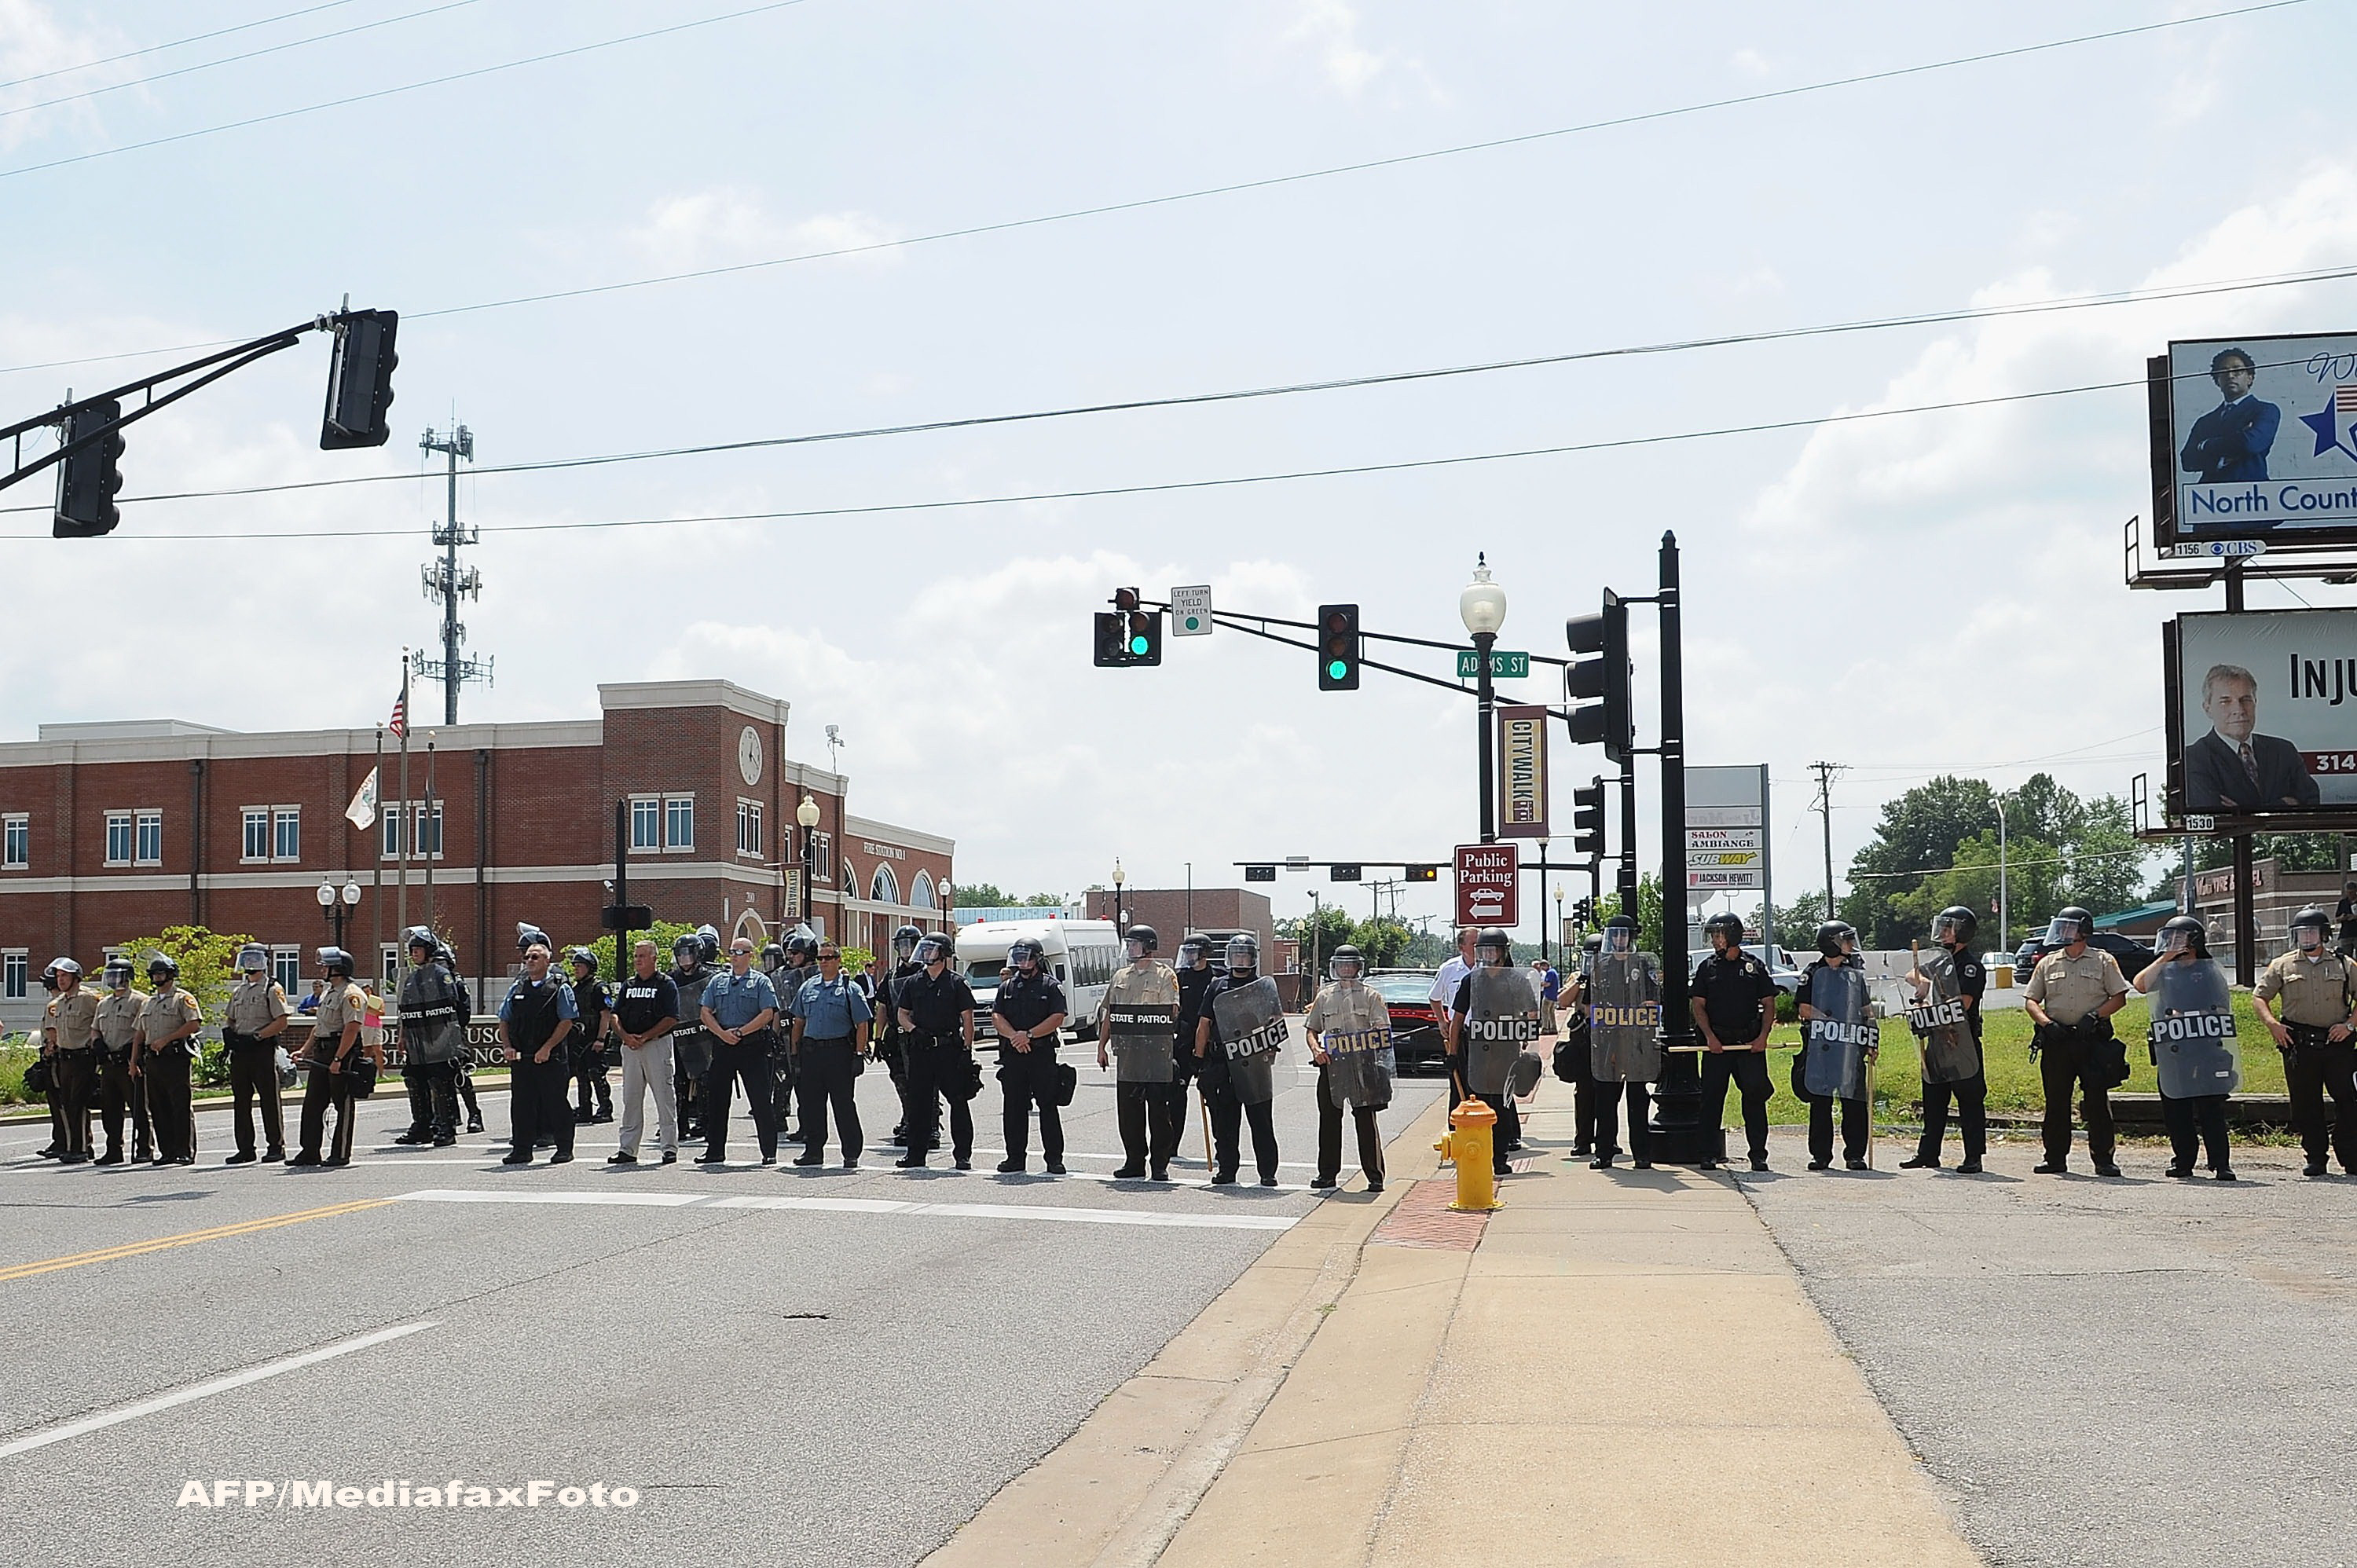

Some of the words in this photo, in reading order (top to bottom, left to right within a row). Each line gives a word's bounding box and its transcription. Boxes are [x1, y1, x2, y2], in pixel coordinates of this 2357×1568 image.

[2192, 485, 2268, 514] North
[2177, 544, 2199, 555] 1156
[2227, 542, 2257, 554] CBS
[1511, 657, 1525, 672] ST
[1512, 721, 1533, 799] CITYWALK
[2317, 754, 2355, 771] 314
[2187, 818, 2212, 829] 1530
[1464, 852, 1508, 868] Public
[1688, 852, 1758, 866] SUBWAY
[1460, 869, 1513, 887] Parking
[1699, 874, 1727, 882] JACKSON
[1729, 874, 1753, 882] HEWITT
[401, 1011, 423, 1020] STATE
[425, 1006, 456, 1017] PATROL
[1109, 1013, 1134, 1023] STATE
[1138, 1015, 1173, 1024] PATROL
[1593, 1007, 1659, 1026] POLICE
[1905, 1002, 1965, 1029] POLICE
[673, 1027, 697, 1038] STATE
[1471, 1020, 1538, 1041] POLICE
[1810, 1020, 1879, 1048] POLICE
[2154, 1016, 2234, 1042] POLICE
[1226, 1021, 1288, 1060] POLICE
[1326, 1030, 1391, 1054] POLICE
